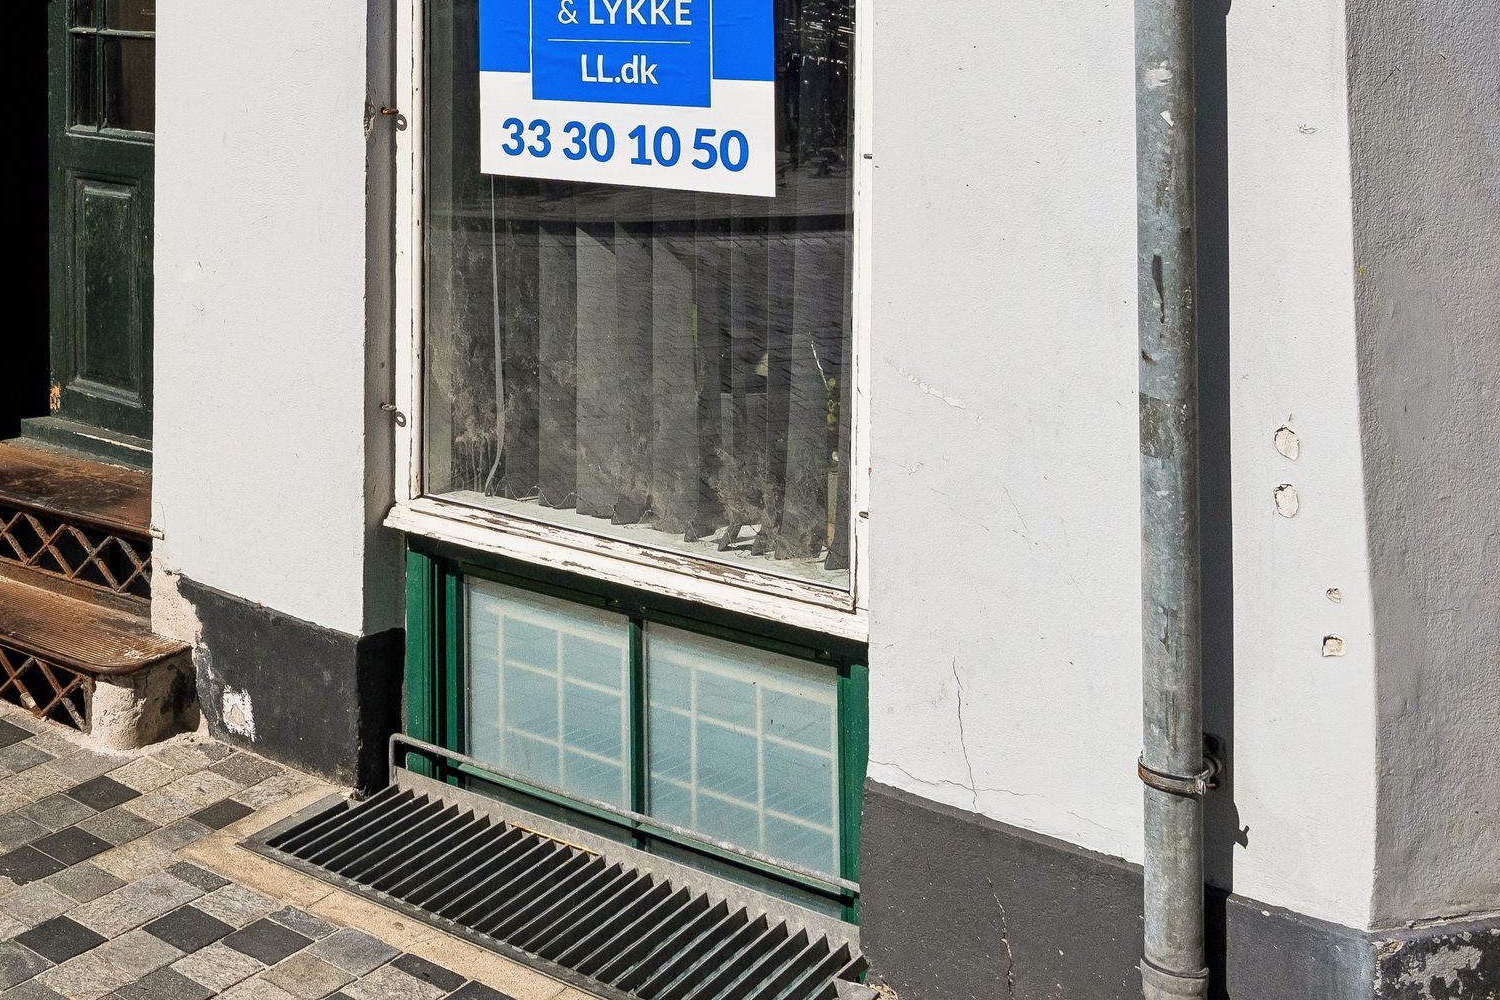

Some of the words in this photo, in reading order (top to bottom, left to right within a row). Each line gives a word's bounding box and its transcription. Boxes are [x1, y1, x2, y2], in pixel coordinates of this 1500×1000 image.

[581, 54, 658, 85] LL.dk
[501, 117, 551, 158] 33
[562, 121, 615, 163] 30
[628, 124, 681, 168] 10
[691, 128, 750, 172] 50
